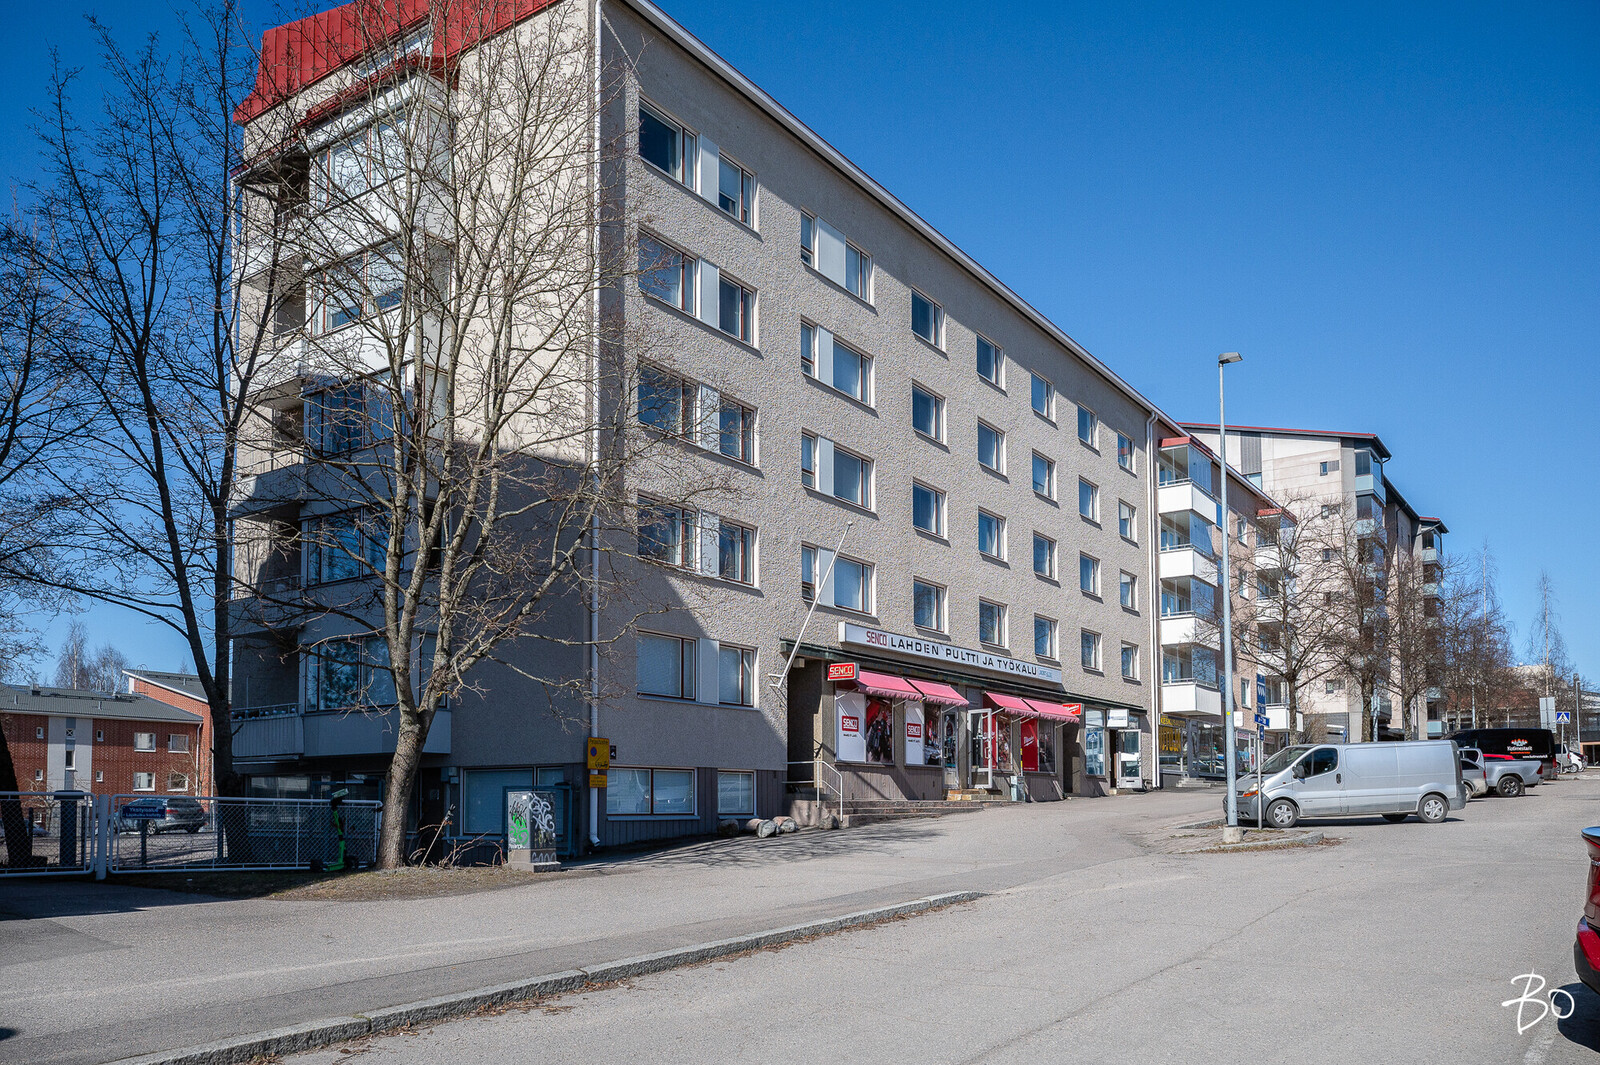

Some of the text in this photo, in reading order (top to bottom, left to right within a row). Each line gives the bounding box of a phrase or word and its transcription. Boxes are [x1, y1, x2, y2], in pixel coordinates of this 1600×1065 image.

[866, 631, 888, 646] SENCO
[890, 637, 939, 655] LAHDEN
[945, 648, 979, 663] PULTTI
[982, 656, 994, 667] JA
[997, 659, 1037, 675] TYÖKALU
[829, 665, 853, 676] SENCO
[843, 718, 858, 728] SENCO
[908, 725, 921, 734] SENCO
